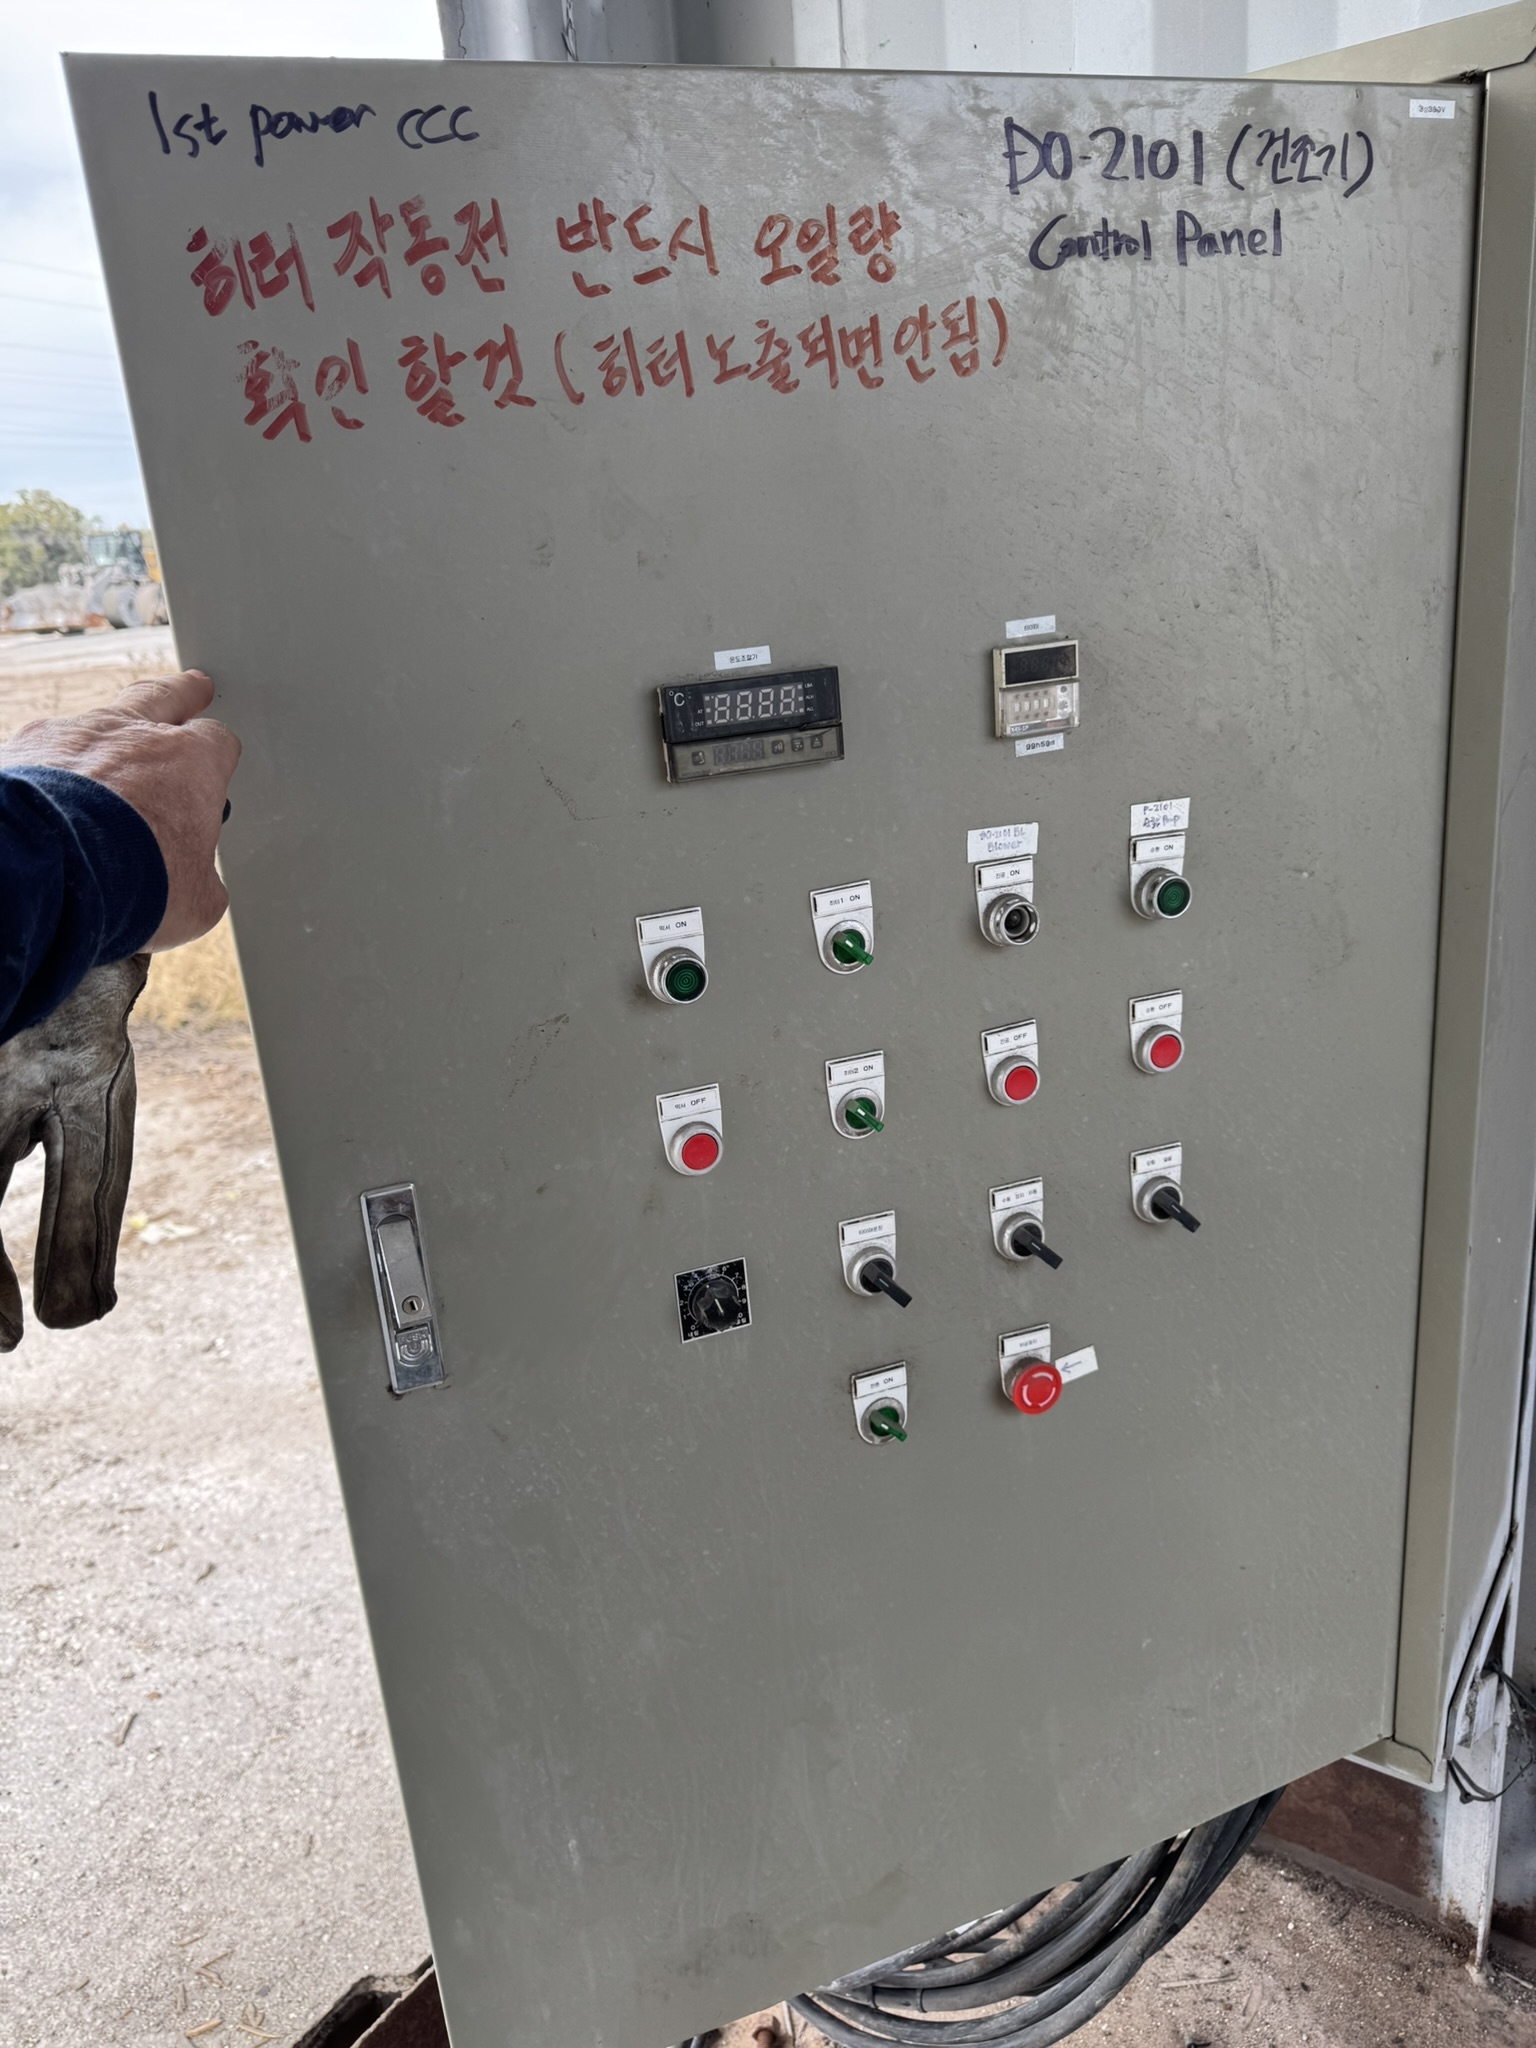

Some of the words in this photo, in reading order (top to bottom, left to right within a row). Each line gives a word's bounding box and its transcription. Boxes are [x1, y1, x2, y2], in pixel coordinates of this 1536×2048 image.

[1028, 213, 1153, 272] Control
[1176, 207, 1283, 267] Panel
[555, 196, 720, 299] 반드시
[753, 200, 902, 286] 오일량
[849, 894, 861, 902] ON
[675, 920, 687, 928] ON
[1158, 1002, 1173, 1011] OFF
[1013, 1032, 1028, 1041] OFF
[862, 1064, 874, 1072] ON
[690, 1096, 706, 1106] OFF
